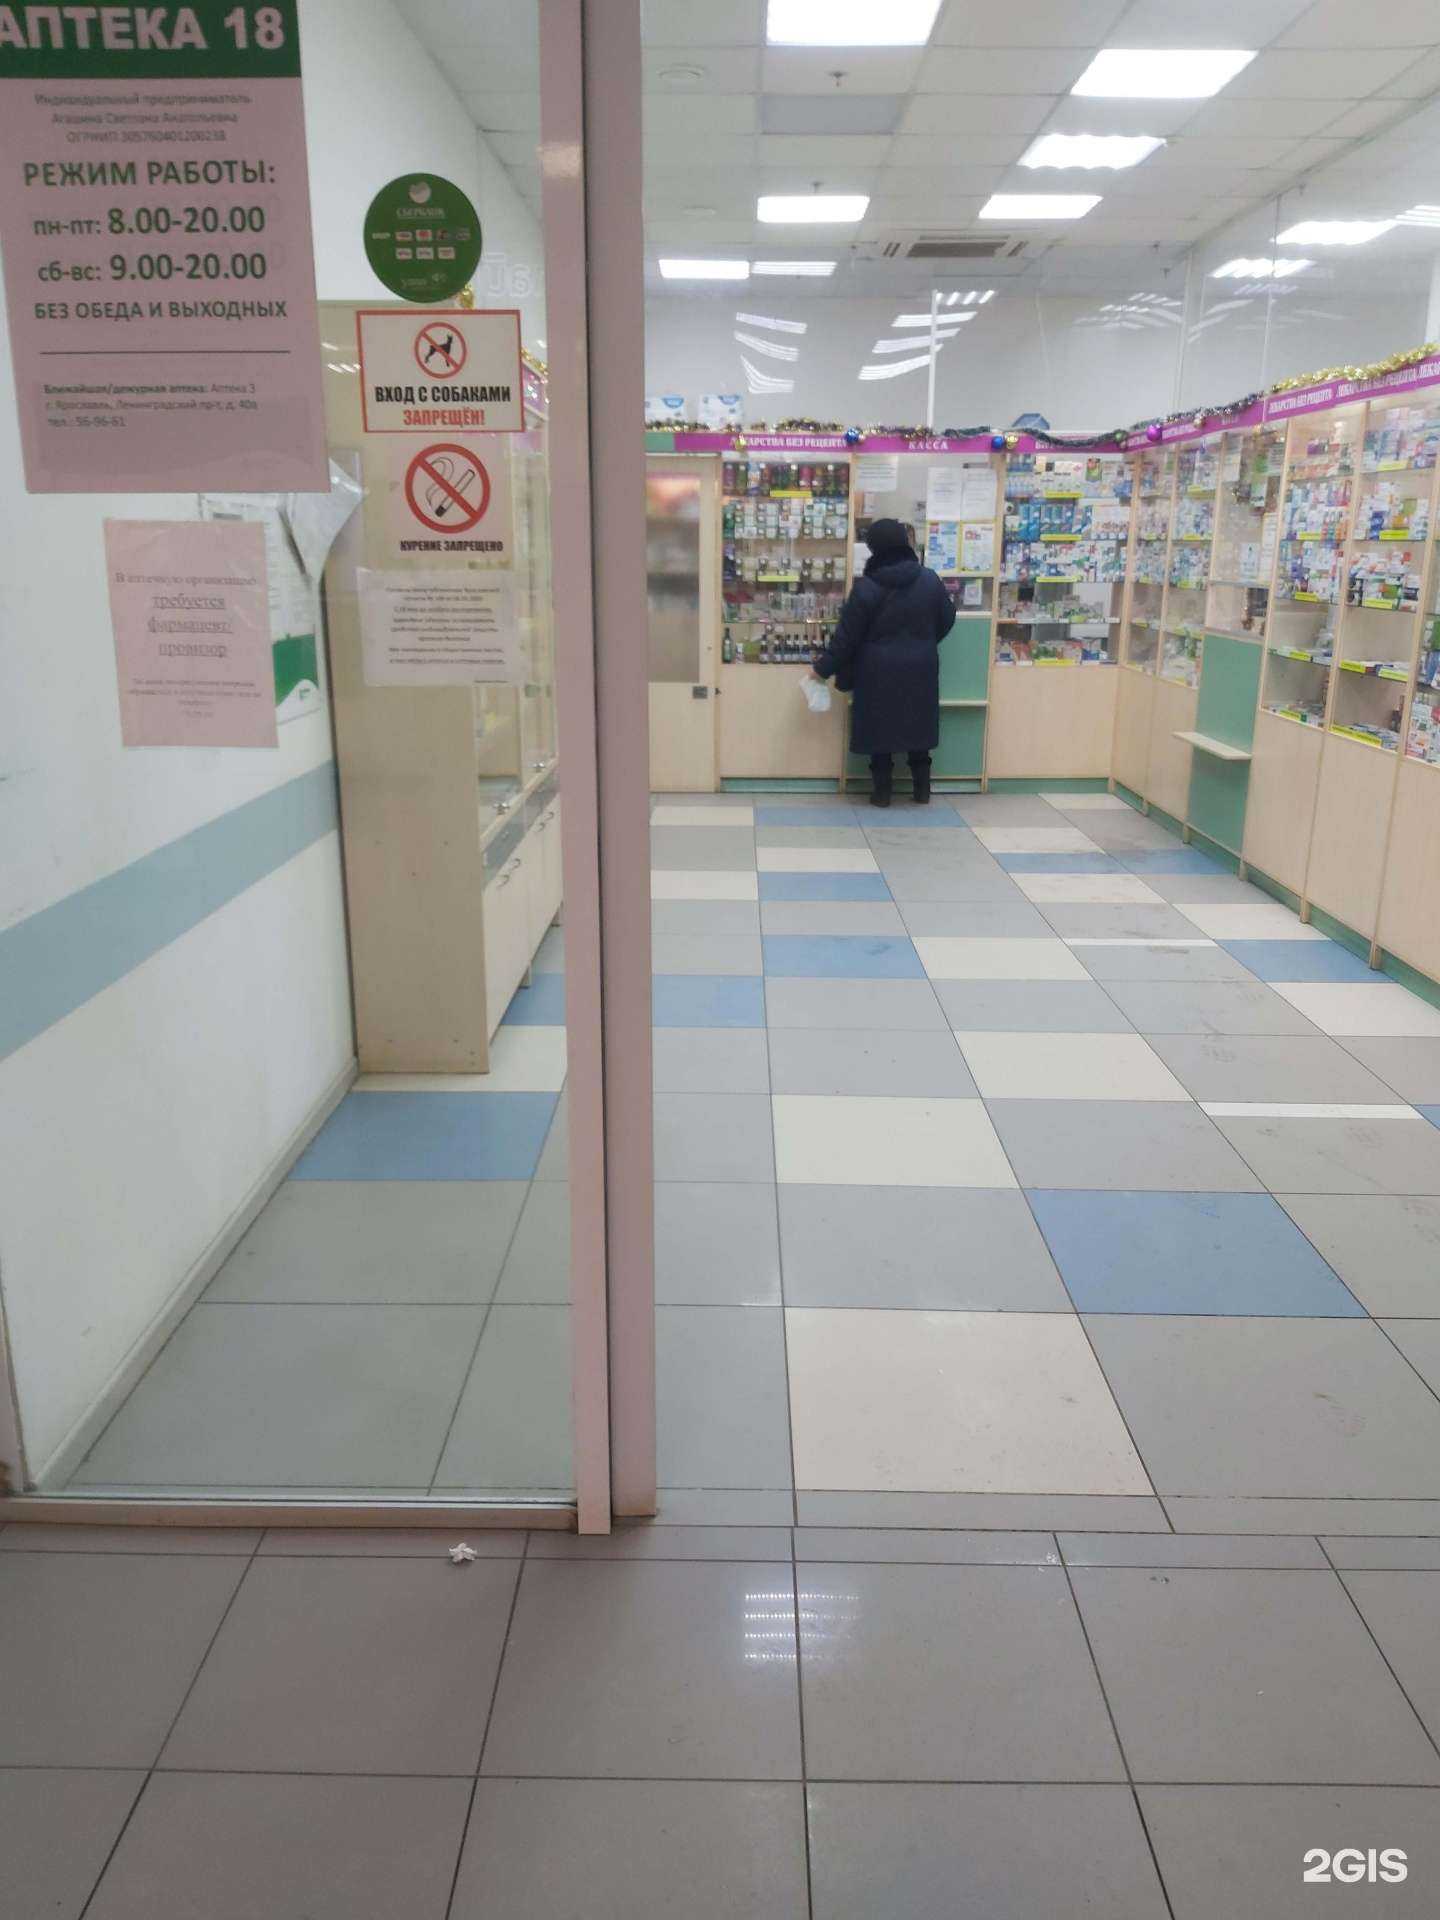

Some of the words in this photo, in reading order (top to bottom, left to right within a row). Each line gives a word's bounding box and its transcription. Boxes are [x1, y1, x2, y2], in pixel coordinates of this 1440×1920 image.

[0, 6, 207, 50] АПТЕКА
[223, 7, 284, 50] 18
[24, 162, 137, 186] РЕЖИМ
[147, 160, 276, 185] РАБОТЫ:
[34, 220, 101, 235] пн-пт:
[109, 206, 265, 235] 8.00-20.00
[38, 260, 101, 281] сб-вс:
[110, 253, 266, 281] 9.00-20.00
[34, 303, 69, 319] БЕЗ
[76, 302, 144, 321] ОБЕДА
[149, 301, 162, 317] И
[168, 301, 287, 320] ВЫХОДНЫХ
[375, 386, 415, 404] ВХОД
[418, 386, 429, 402] С
[431, 385, 511, 402] СОБАКАМИ
[404, 406, 485, 427] ЗАПРЕЩЁН!
[908, 440, 949, 450] КАССА
[400, 540, 442, 552] КУРЕНИЕ
[443, 540, 504, 553] ЗАПРЕЩЕНО
